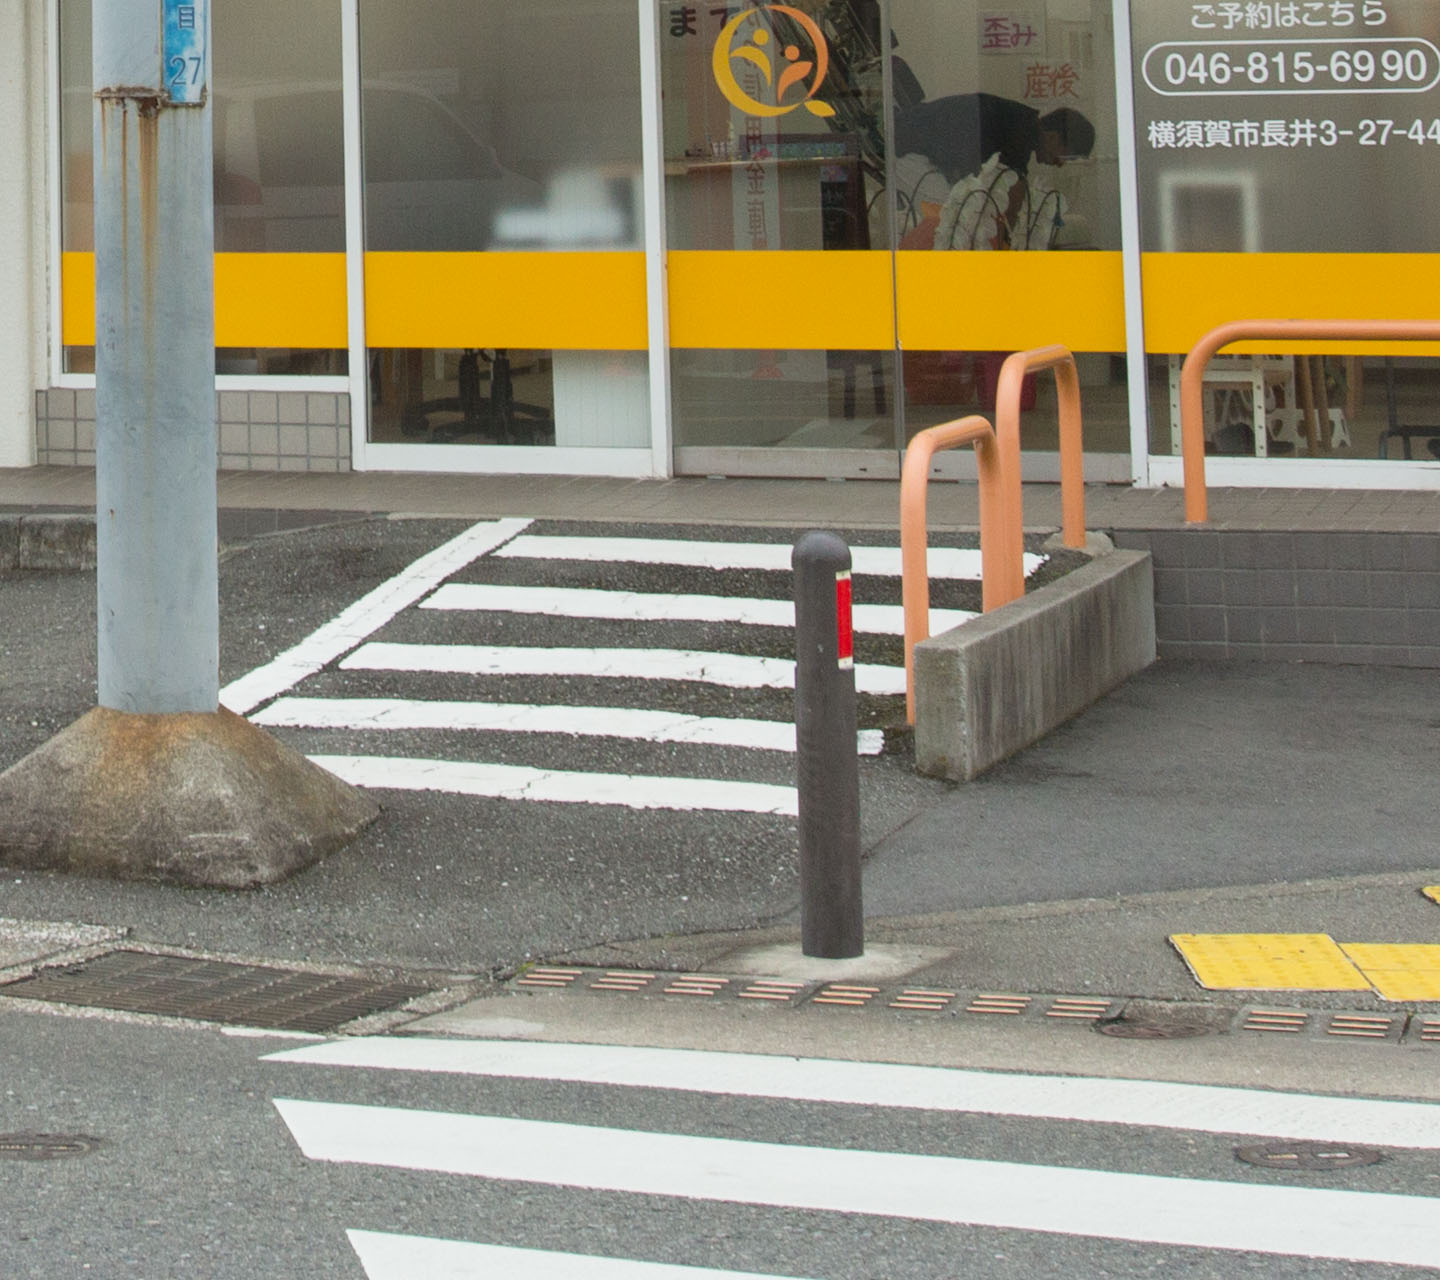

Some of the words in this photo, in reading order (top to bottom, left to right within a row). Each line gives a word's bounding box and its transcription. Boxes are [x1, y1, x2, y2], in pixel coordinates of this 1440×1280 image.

[1191, 0, 1387, 30] ご予約はこちら
[982, 17, 1038, 49] 歪み
[171, 56, 201, 86] 27
[1024, 62, 1081, 100] 産後
[1165, 49, 1427, 85] 046-815-6990
